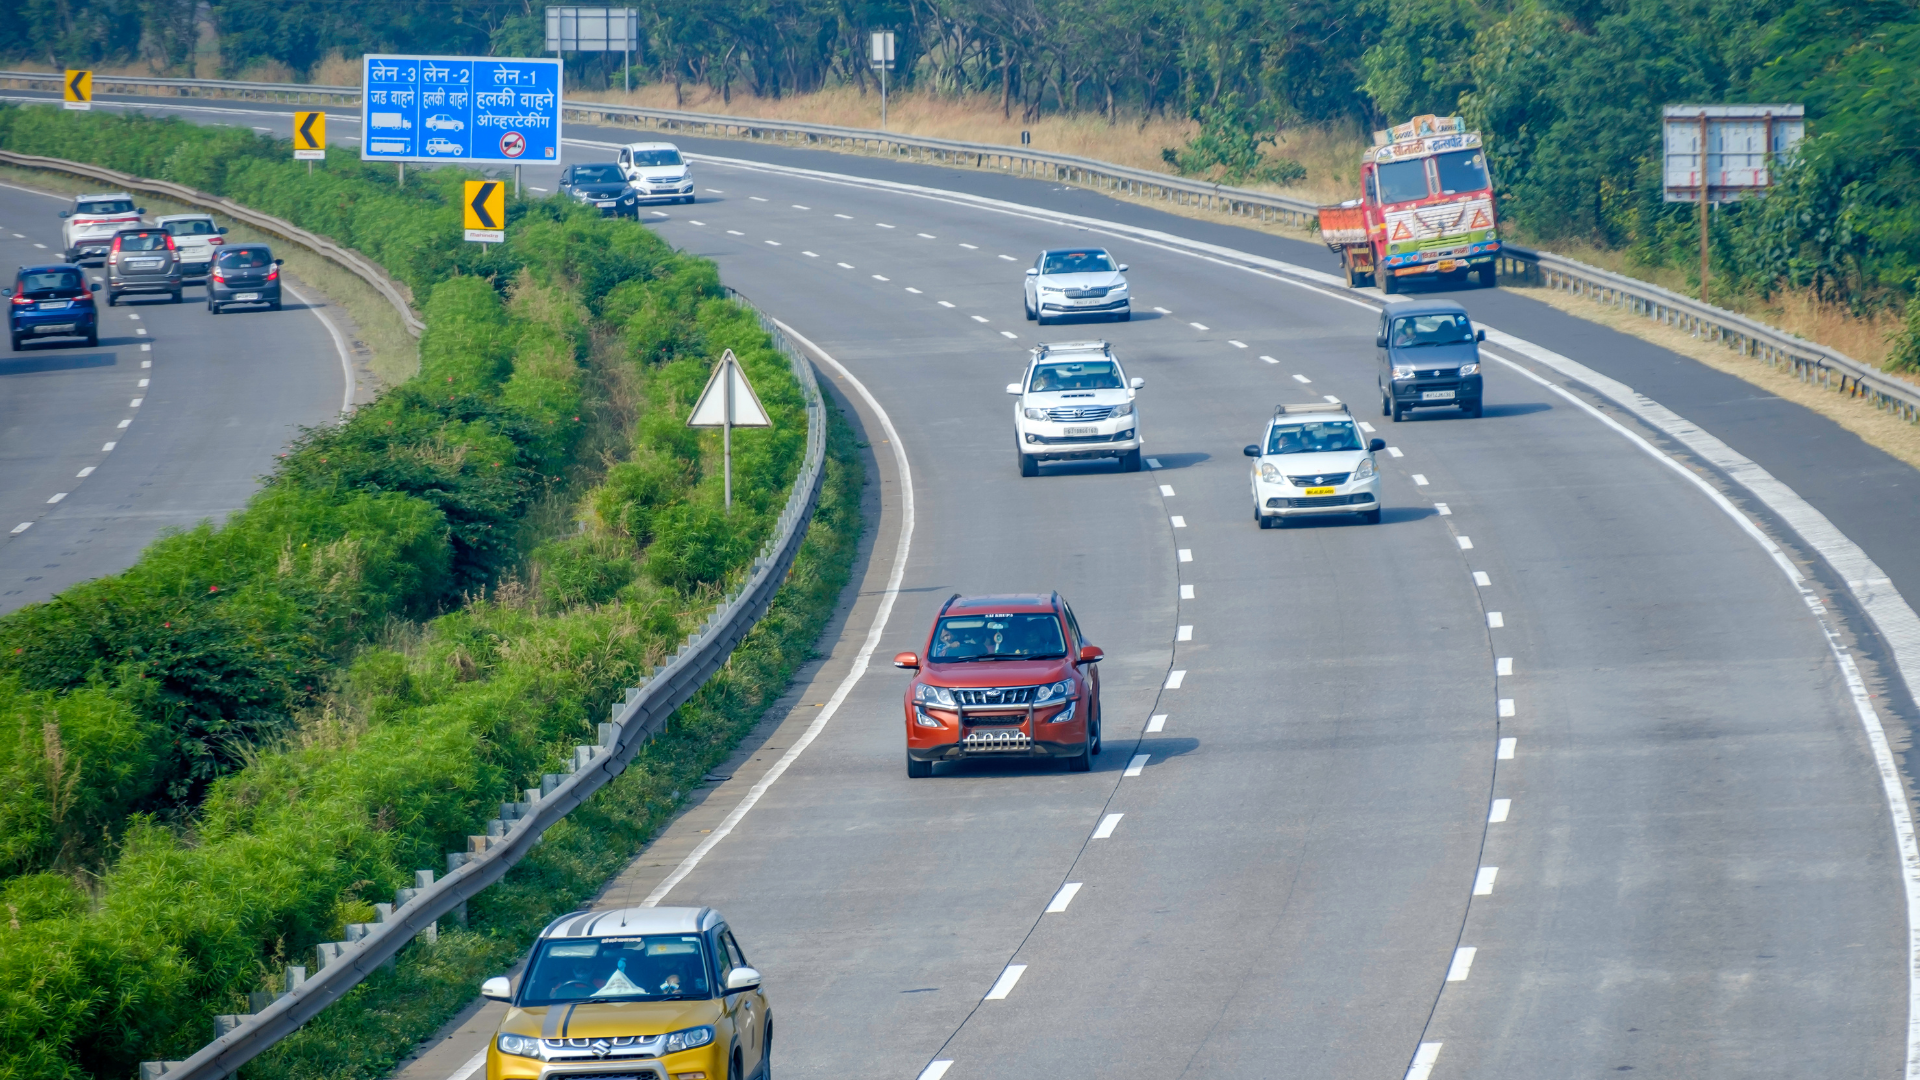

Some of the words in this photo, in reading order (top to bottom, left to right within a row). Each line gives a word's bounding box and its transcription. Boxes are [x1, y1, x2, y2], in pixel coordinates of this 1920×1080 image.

[371, 60, 399, 81] लेन
[423, 61, 450, 83] लेन
[493, 63, 520, 85] लेन
[370, 90, 388, 105] जड
[390, 85, 415, 108] वाहने
[423, 86, 446, 109] हलकी
[449, 86, 469, 110] वाहने
[475, 87, 516, 109] हलकी
[519, 87, 555, 111] वाहने
[477, 110, 551, 130] ओव्हरटेकींग
